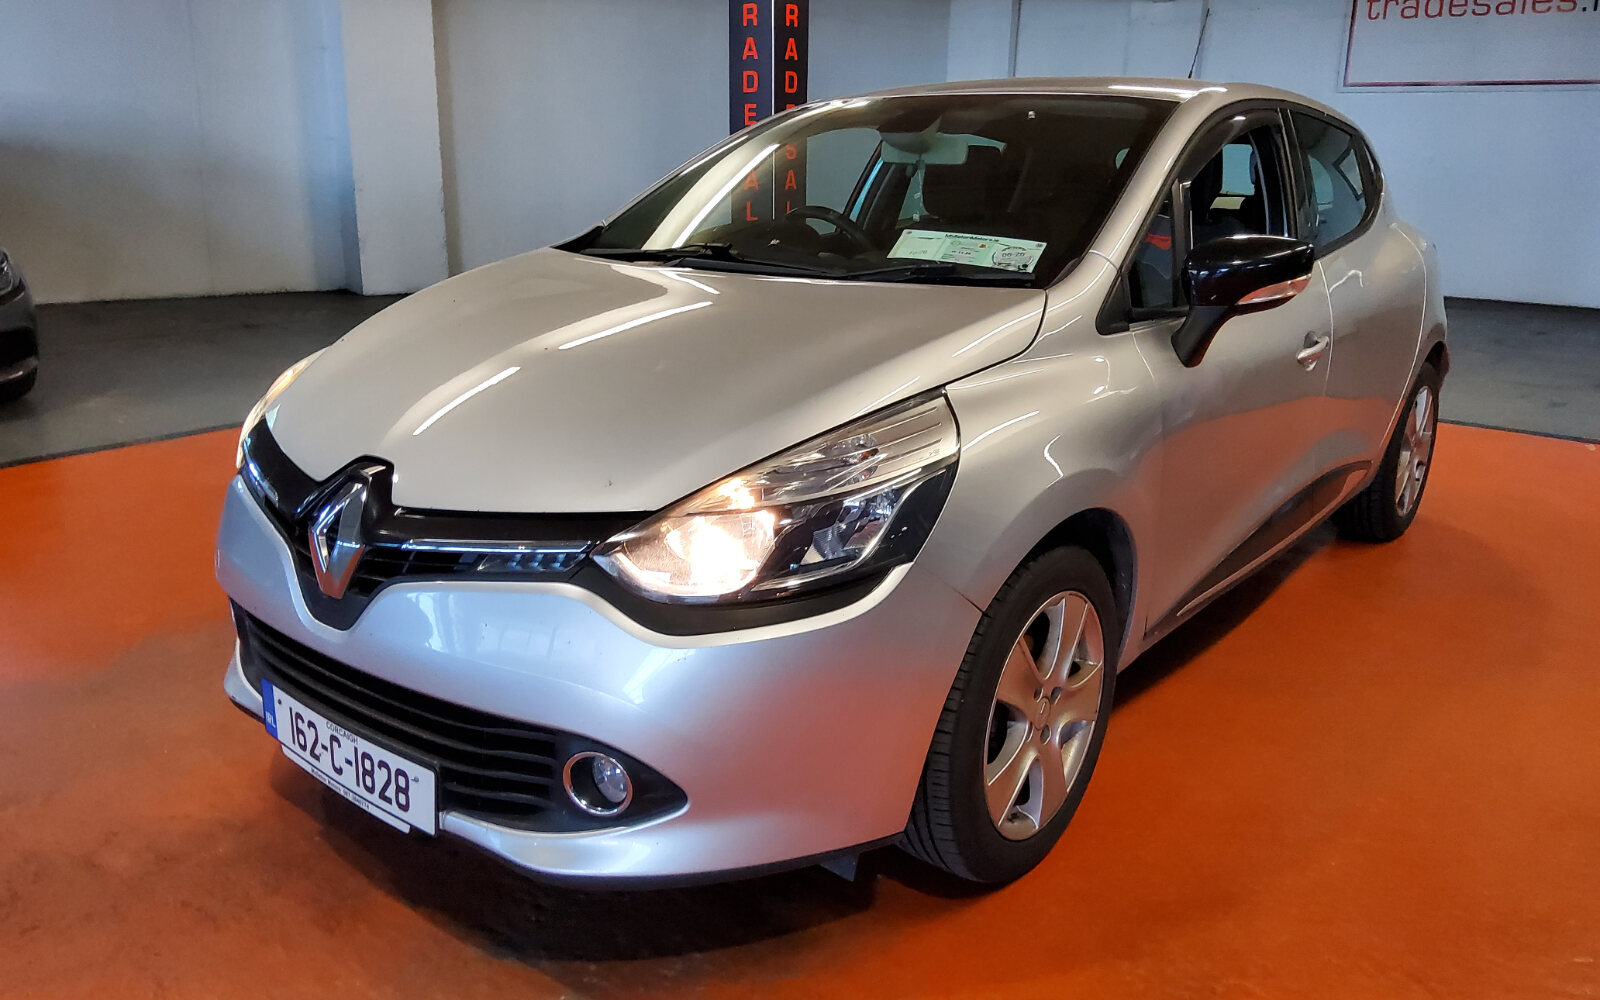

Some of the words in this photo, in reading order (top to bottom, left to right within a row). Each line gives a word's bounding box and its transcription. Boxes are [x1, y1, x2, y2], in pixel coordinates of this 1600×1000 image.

[784, 3, 799, 110] RAD
[265, 710, 277, 728] IRL
[325, 721, 359, 745] CORCAIGH
[288, 706, 411, 813] 162-C-1828
